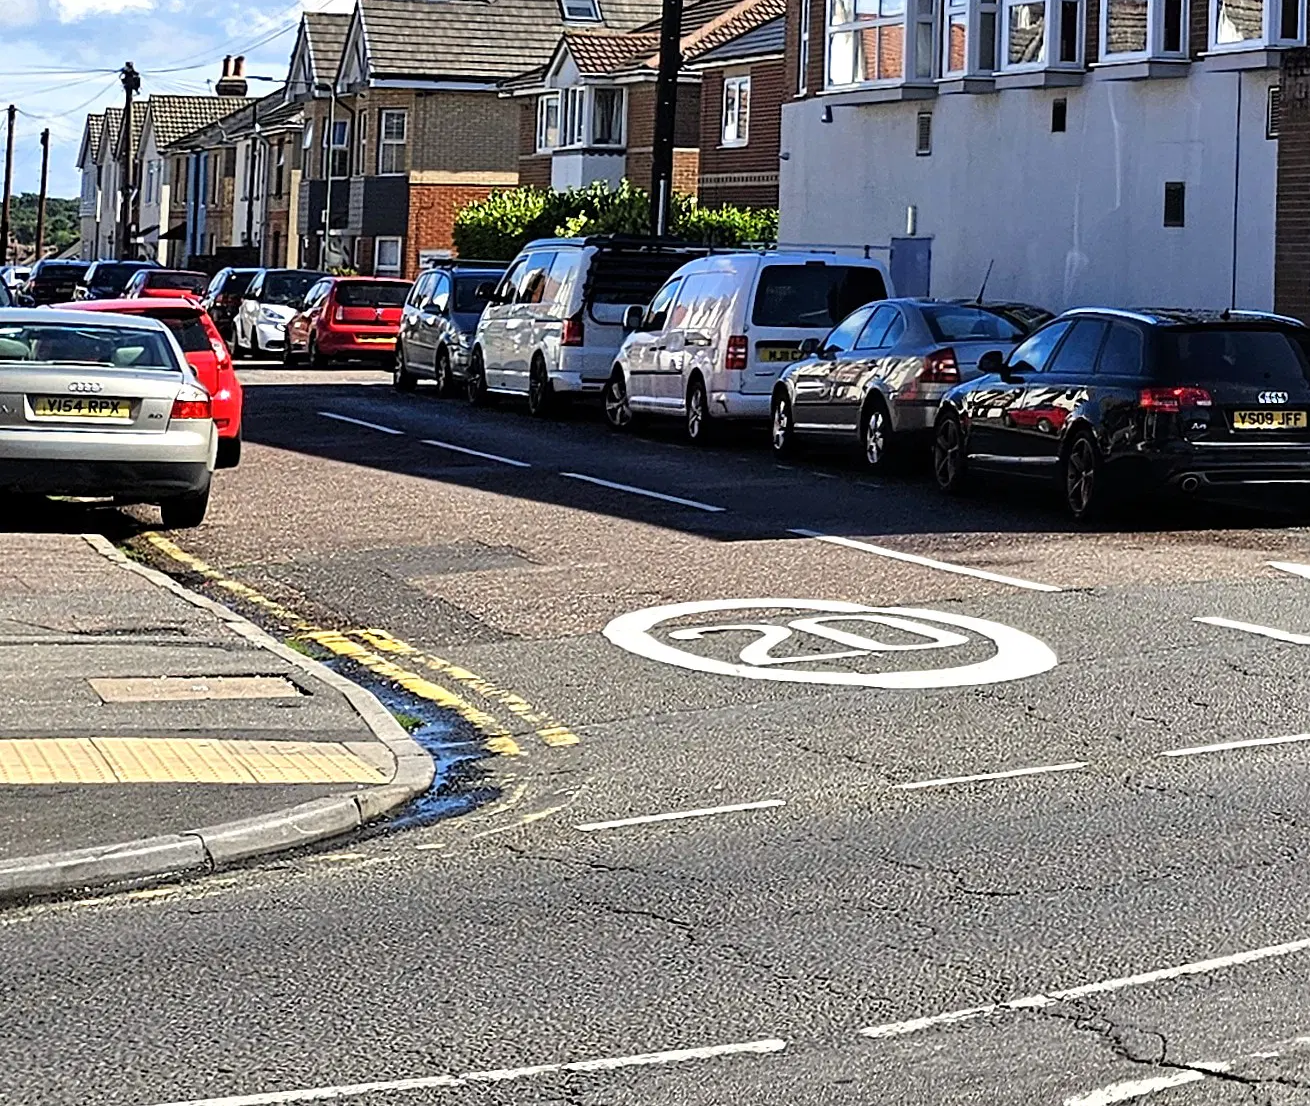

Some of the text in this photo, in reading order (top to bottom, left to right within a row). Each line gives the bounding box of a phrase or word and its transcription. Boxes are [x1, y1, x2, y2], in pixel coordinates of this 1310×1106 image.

[88, 399, 120, 414] RPX
[1239, 412, 1302, 426] YS09 JFF
[668, 614, 970, 667] 20
